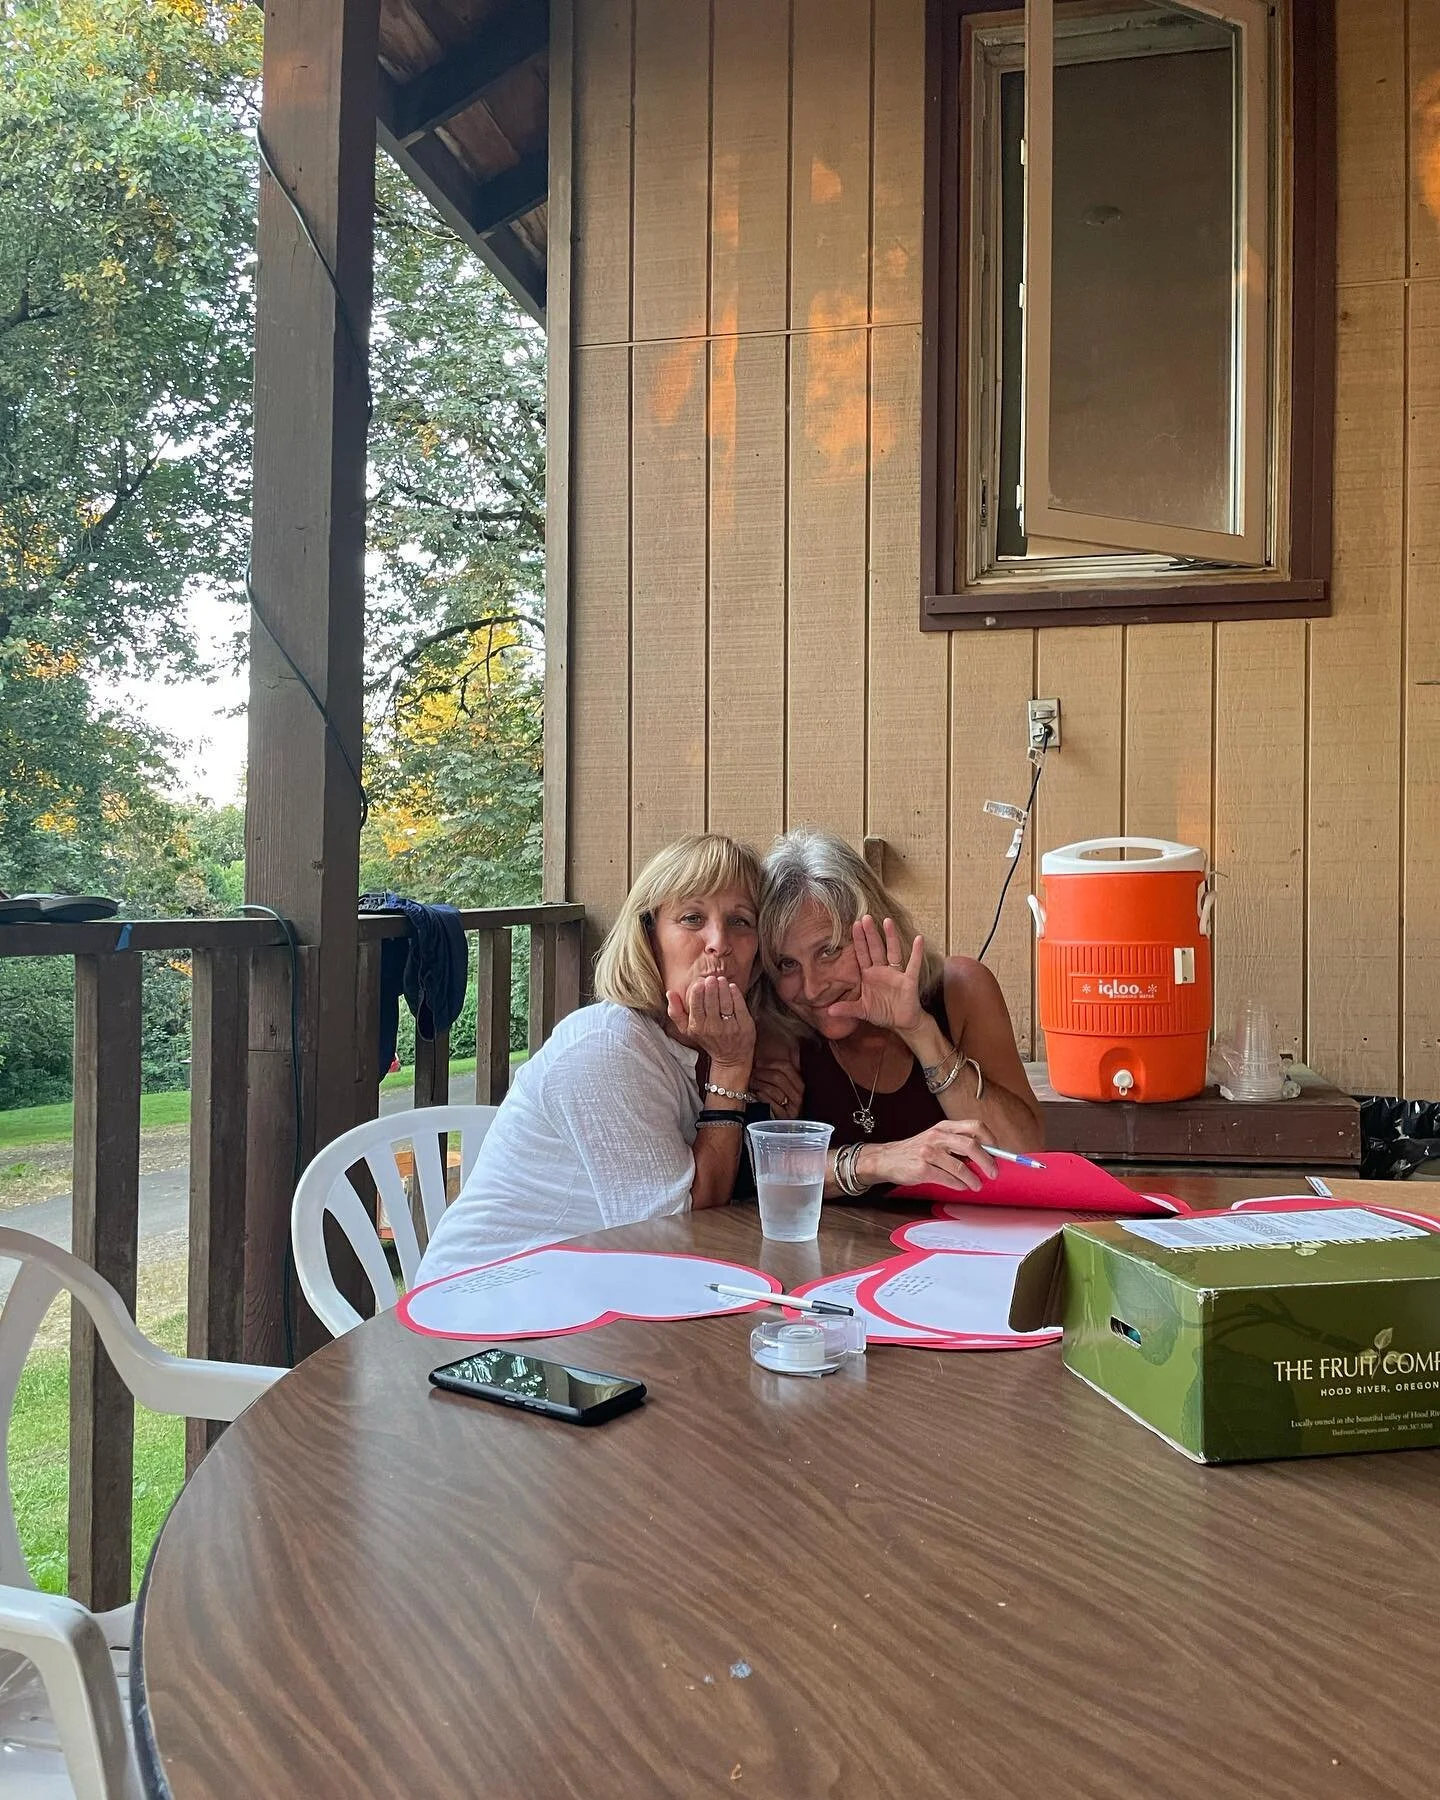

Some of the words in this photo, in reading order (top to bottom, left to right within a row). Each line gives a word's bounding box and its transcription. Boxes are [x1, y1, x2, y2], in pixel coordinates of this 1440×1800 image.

[1098, 978, 1139, 998] igloo
[1273, 1359, 1313, 1382] THE
[1319, 1356, 1378, 1378] FRUIT
[1320, 1387, 1352, 1397] HOOD
[1395, 1381, 1440, 1392] OREGON
[1291, 1418, 1313, 1429] Locally
[1314, 1416, 1336, 1426] owned
[1344, 1415, 1355, 1424] the
[1355, 1412, 1383, 1423] beautiful
[1384, 1411, 1401, 1422] valley
[1402, 1410, 1410, 1419] of
[1410, 1410, 1429, 1419] Hood
